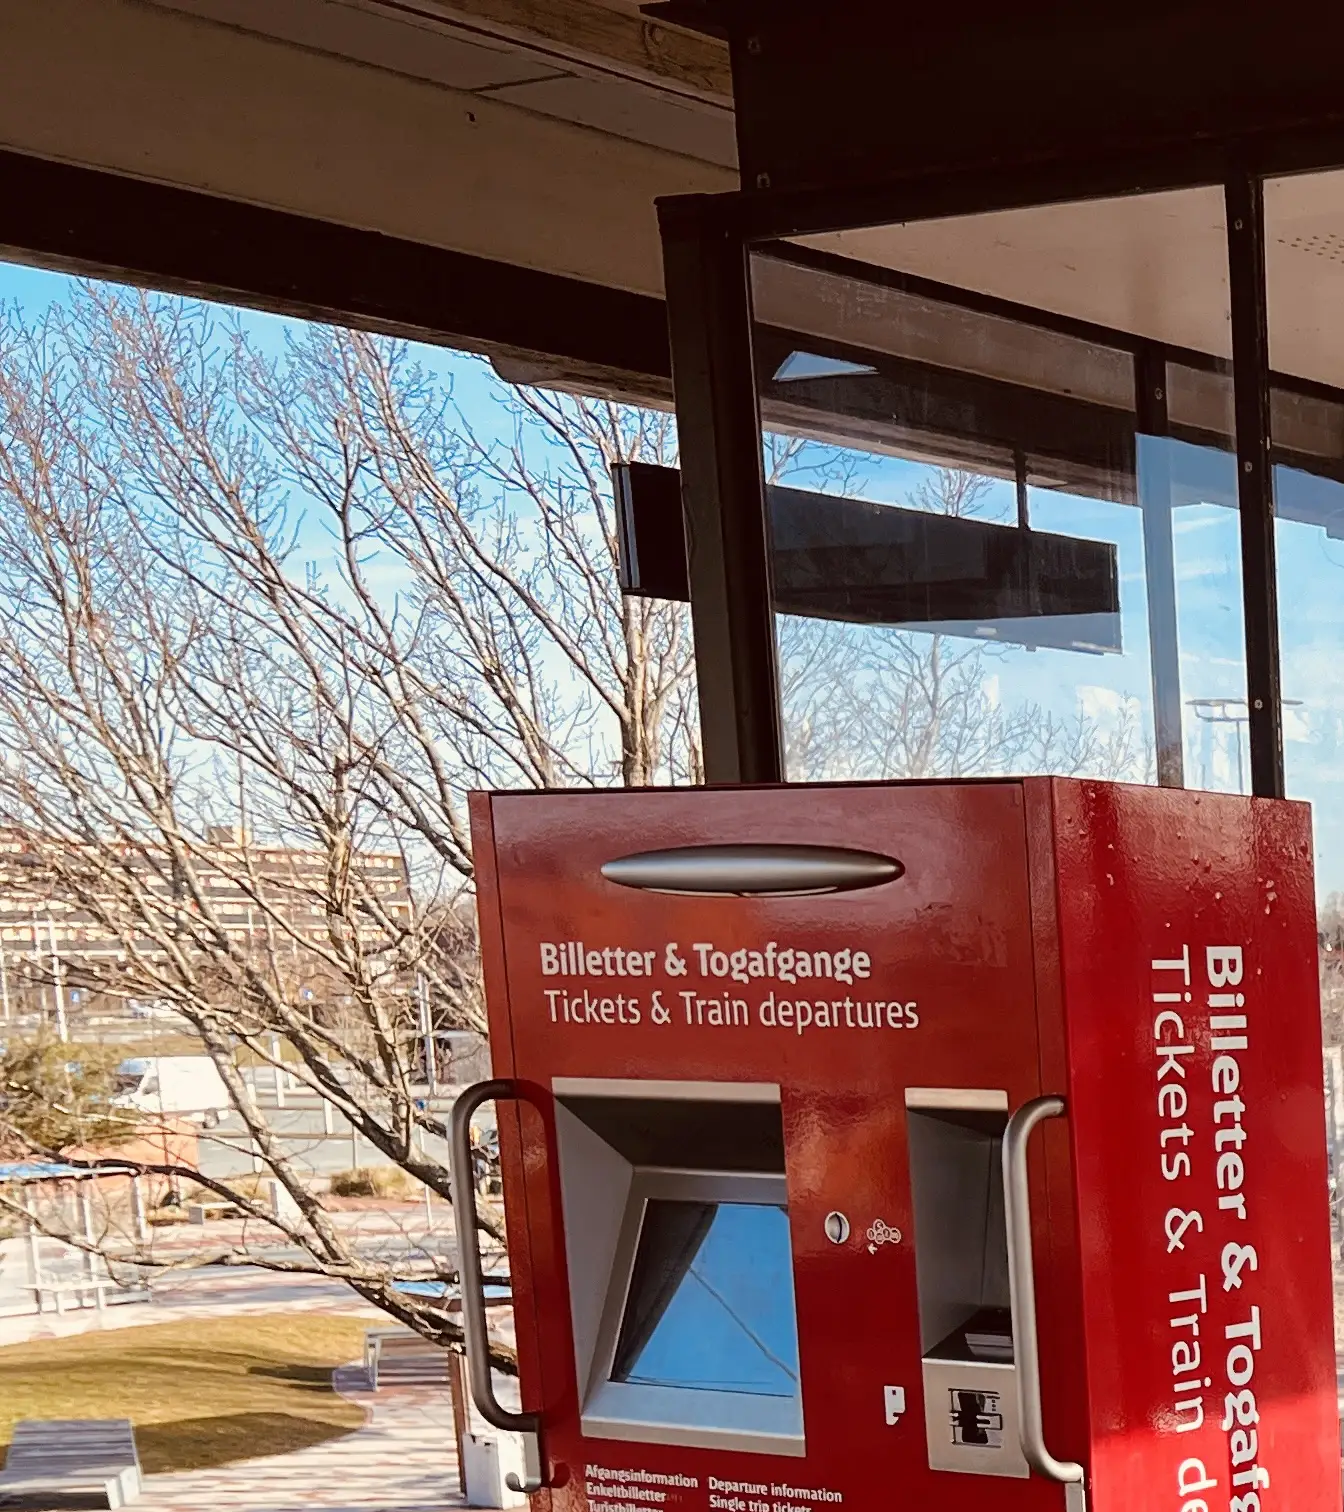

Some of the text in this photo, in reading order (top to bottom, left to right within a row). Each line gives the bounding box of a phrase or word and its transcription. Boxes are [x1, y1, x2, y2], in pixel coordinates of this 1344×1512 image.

[540, 941, 871, 985] Billetter & Togafgange
[543, 989, 919, 1035] Tickets & Train departures
[1151, 944, 1194, 1181] Tickets
[1206, 946, 1248, 1220] Billetter
[1164, 1207, 1203, 1253] &
[1221, 1242, 1258, 1292] &
[1169, 1273, 1211, 1433] Train
[585, 1464, 698, 1488] Afgangsinformation
[586, 1482, 666, 1502] Enkeltbilletter
[708, 1476, 843, 1503] Departure information
[709, 1495, 745, 1512] Single
